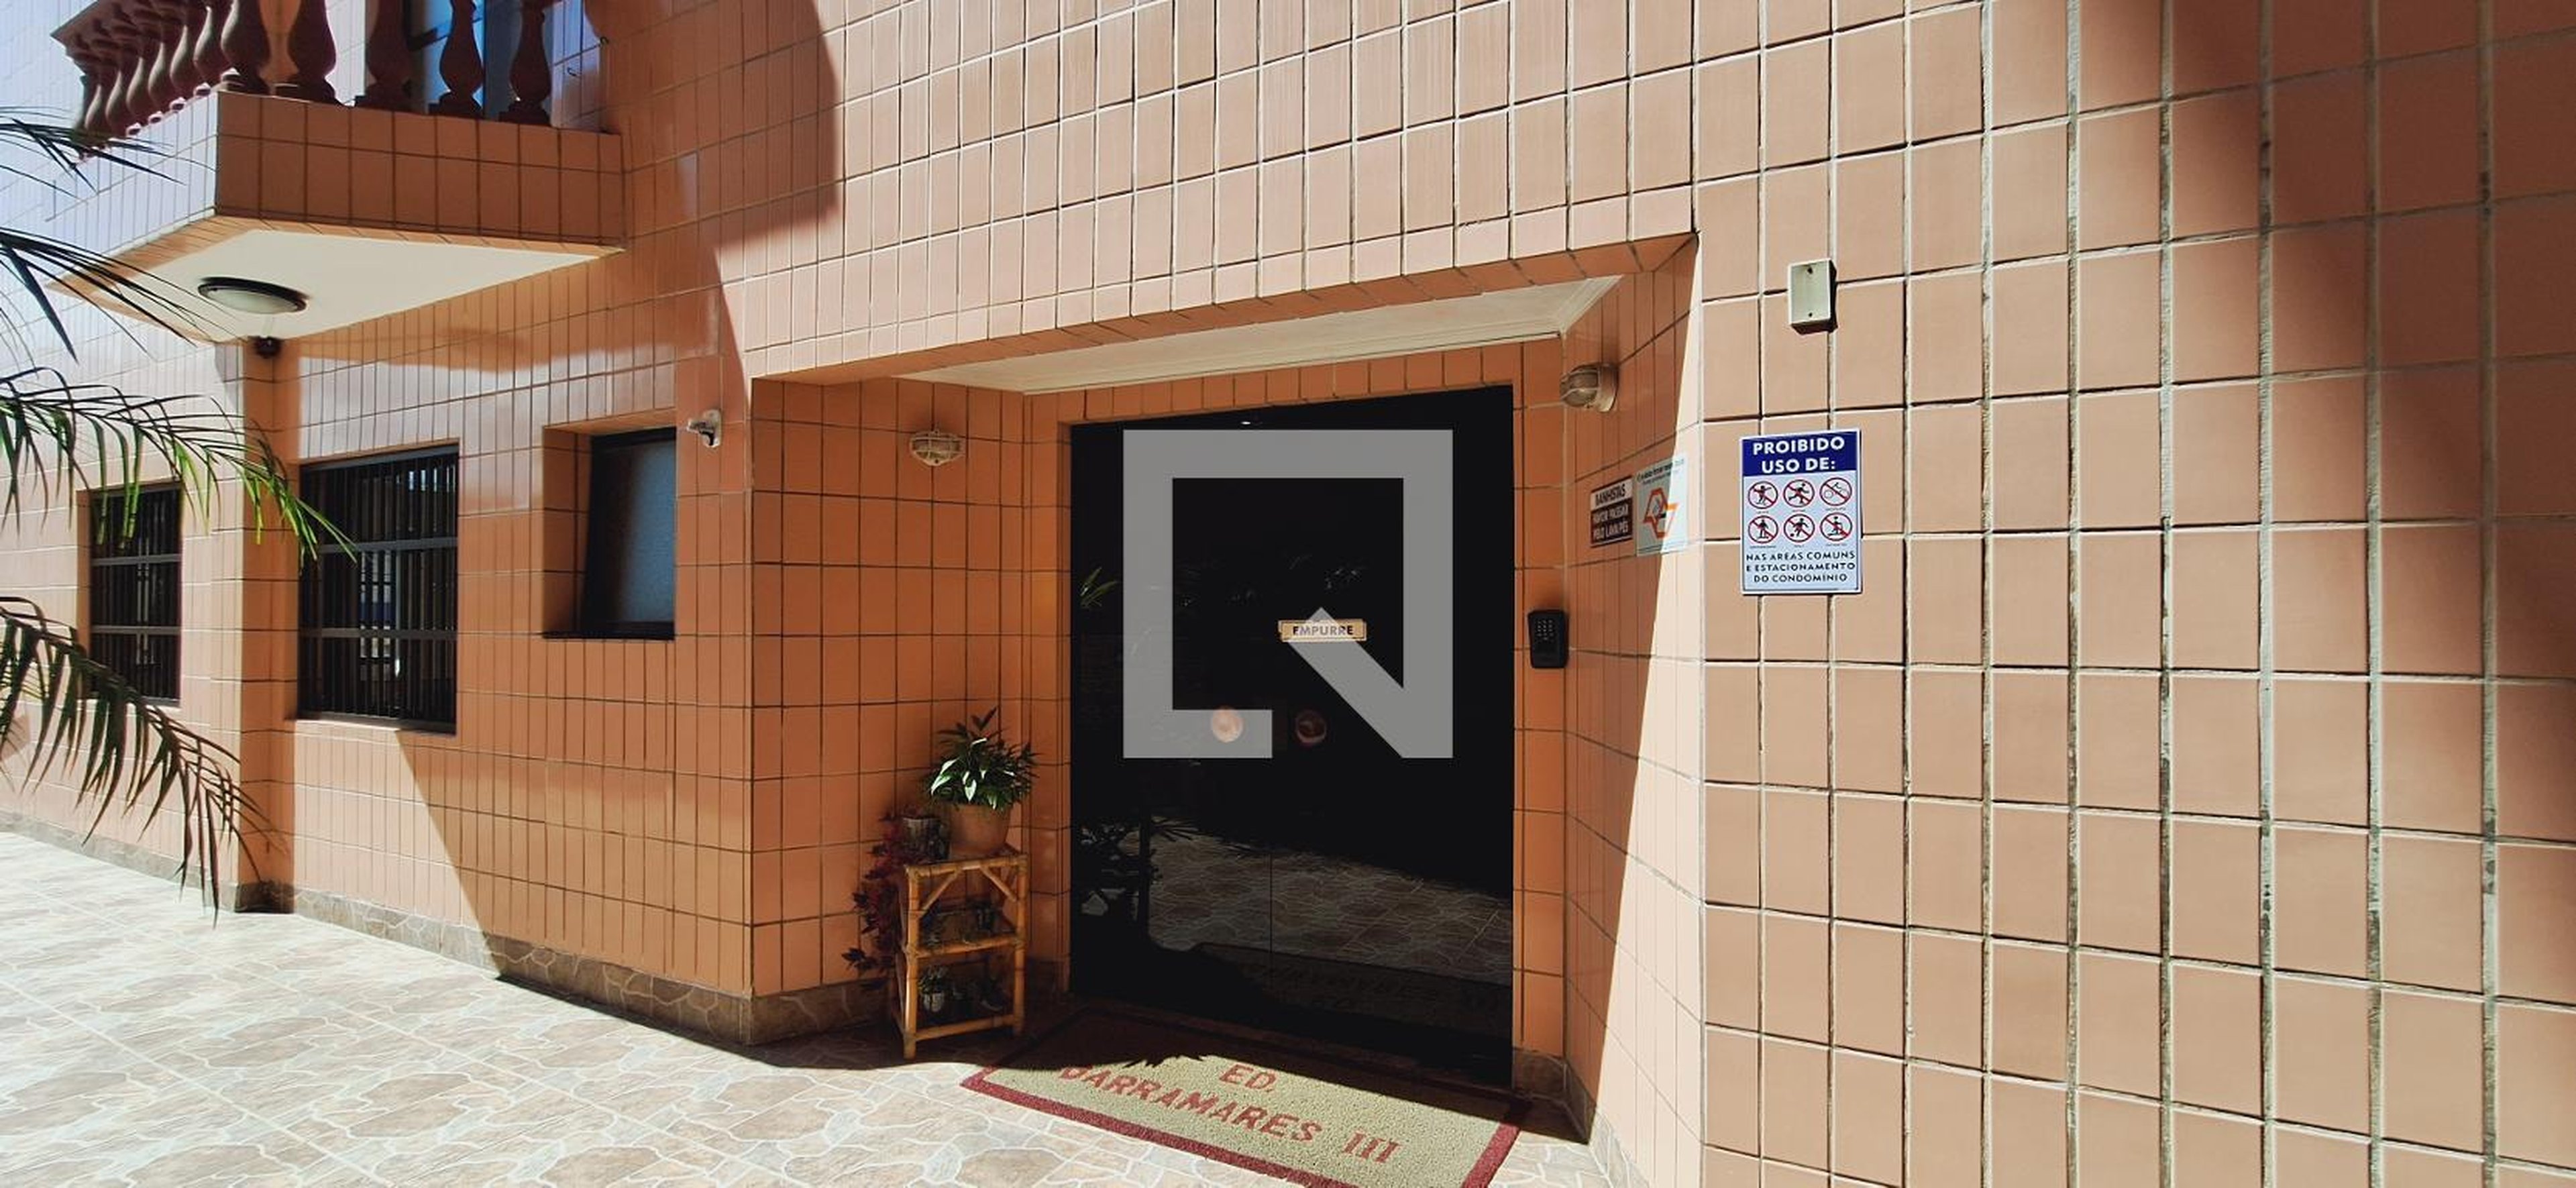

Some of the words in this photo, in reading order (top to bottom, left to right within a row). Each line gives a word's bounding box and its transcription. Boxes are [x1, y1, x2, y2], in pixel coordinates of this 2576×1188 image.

[1753, 436, 1845, 455] PROIBIDO
[1762, 458, 1800, 474] USO
[1805, 457, 1835, 471] DE:
[1746, 553, 1766, 561] NAS
[1807, 550, 1856, 560] COMUNS
[1755, 562, 1856, 572] ESTACIONAMENTO
[1754, 575, 1769, 583] DO
[1293, 625, 1354, 636] EMPURRE
[1343, 1126, 1401, 1163] III
